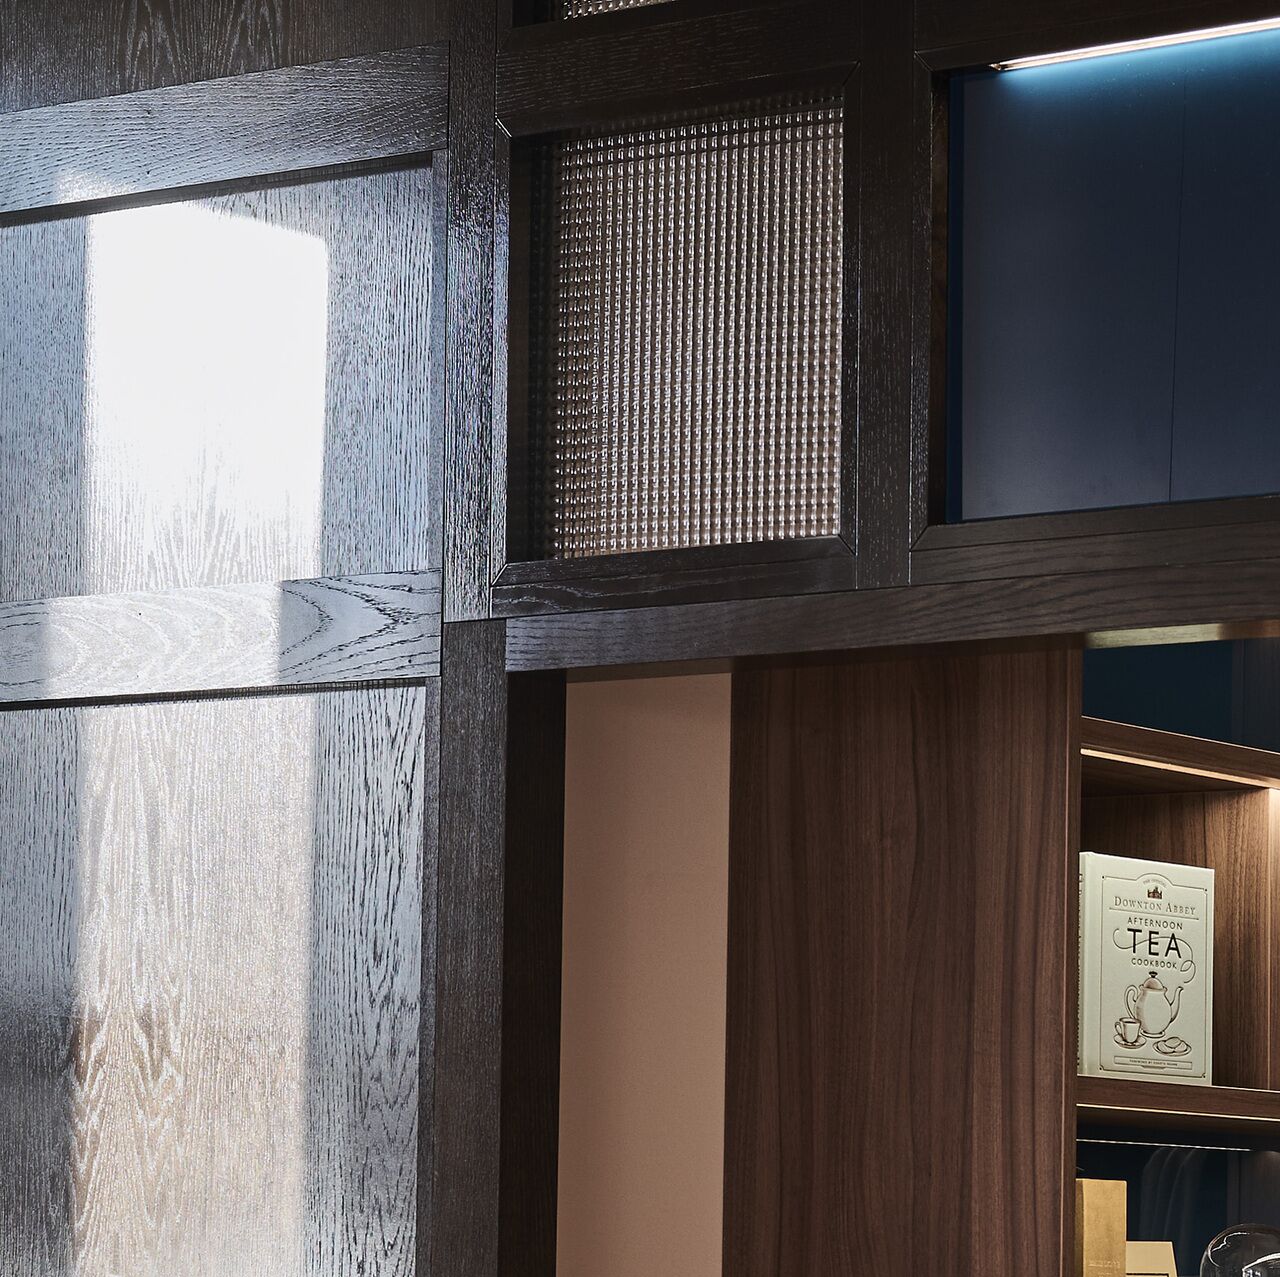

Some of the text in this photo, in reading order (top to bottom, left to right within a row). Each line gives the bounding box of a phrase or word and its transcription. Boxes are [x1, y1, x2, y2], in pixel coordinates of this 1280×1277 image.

[1114, 896, 1196, 915] DOWNTON ABBEY
[1127, 917, 1183, 930] AFTERNOON
[1127, 928, 1182, 959] TEA
[1131, 958, 1177, 970] COOKBOOK
